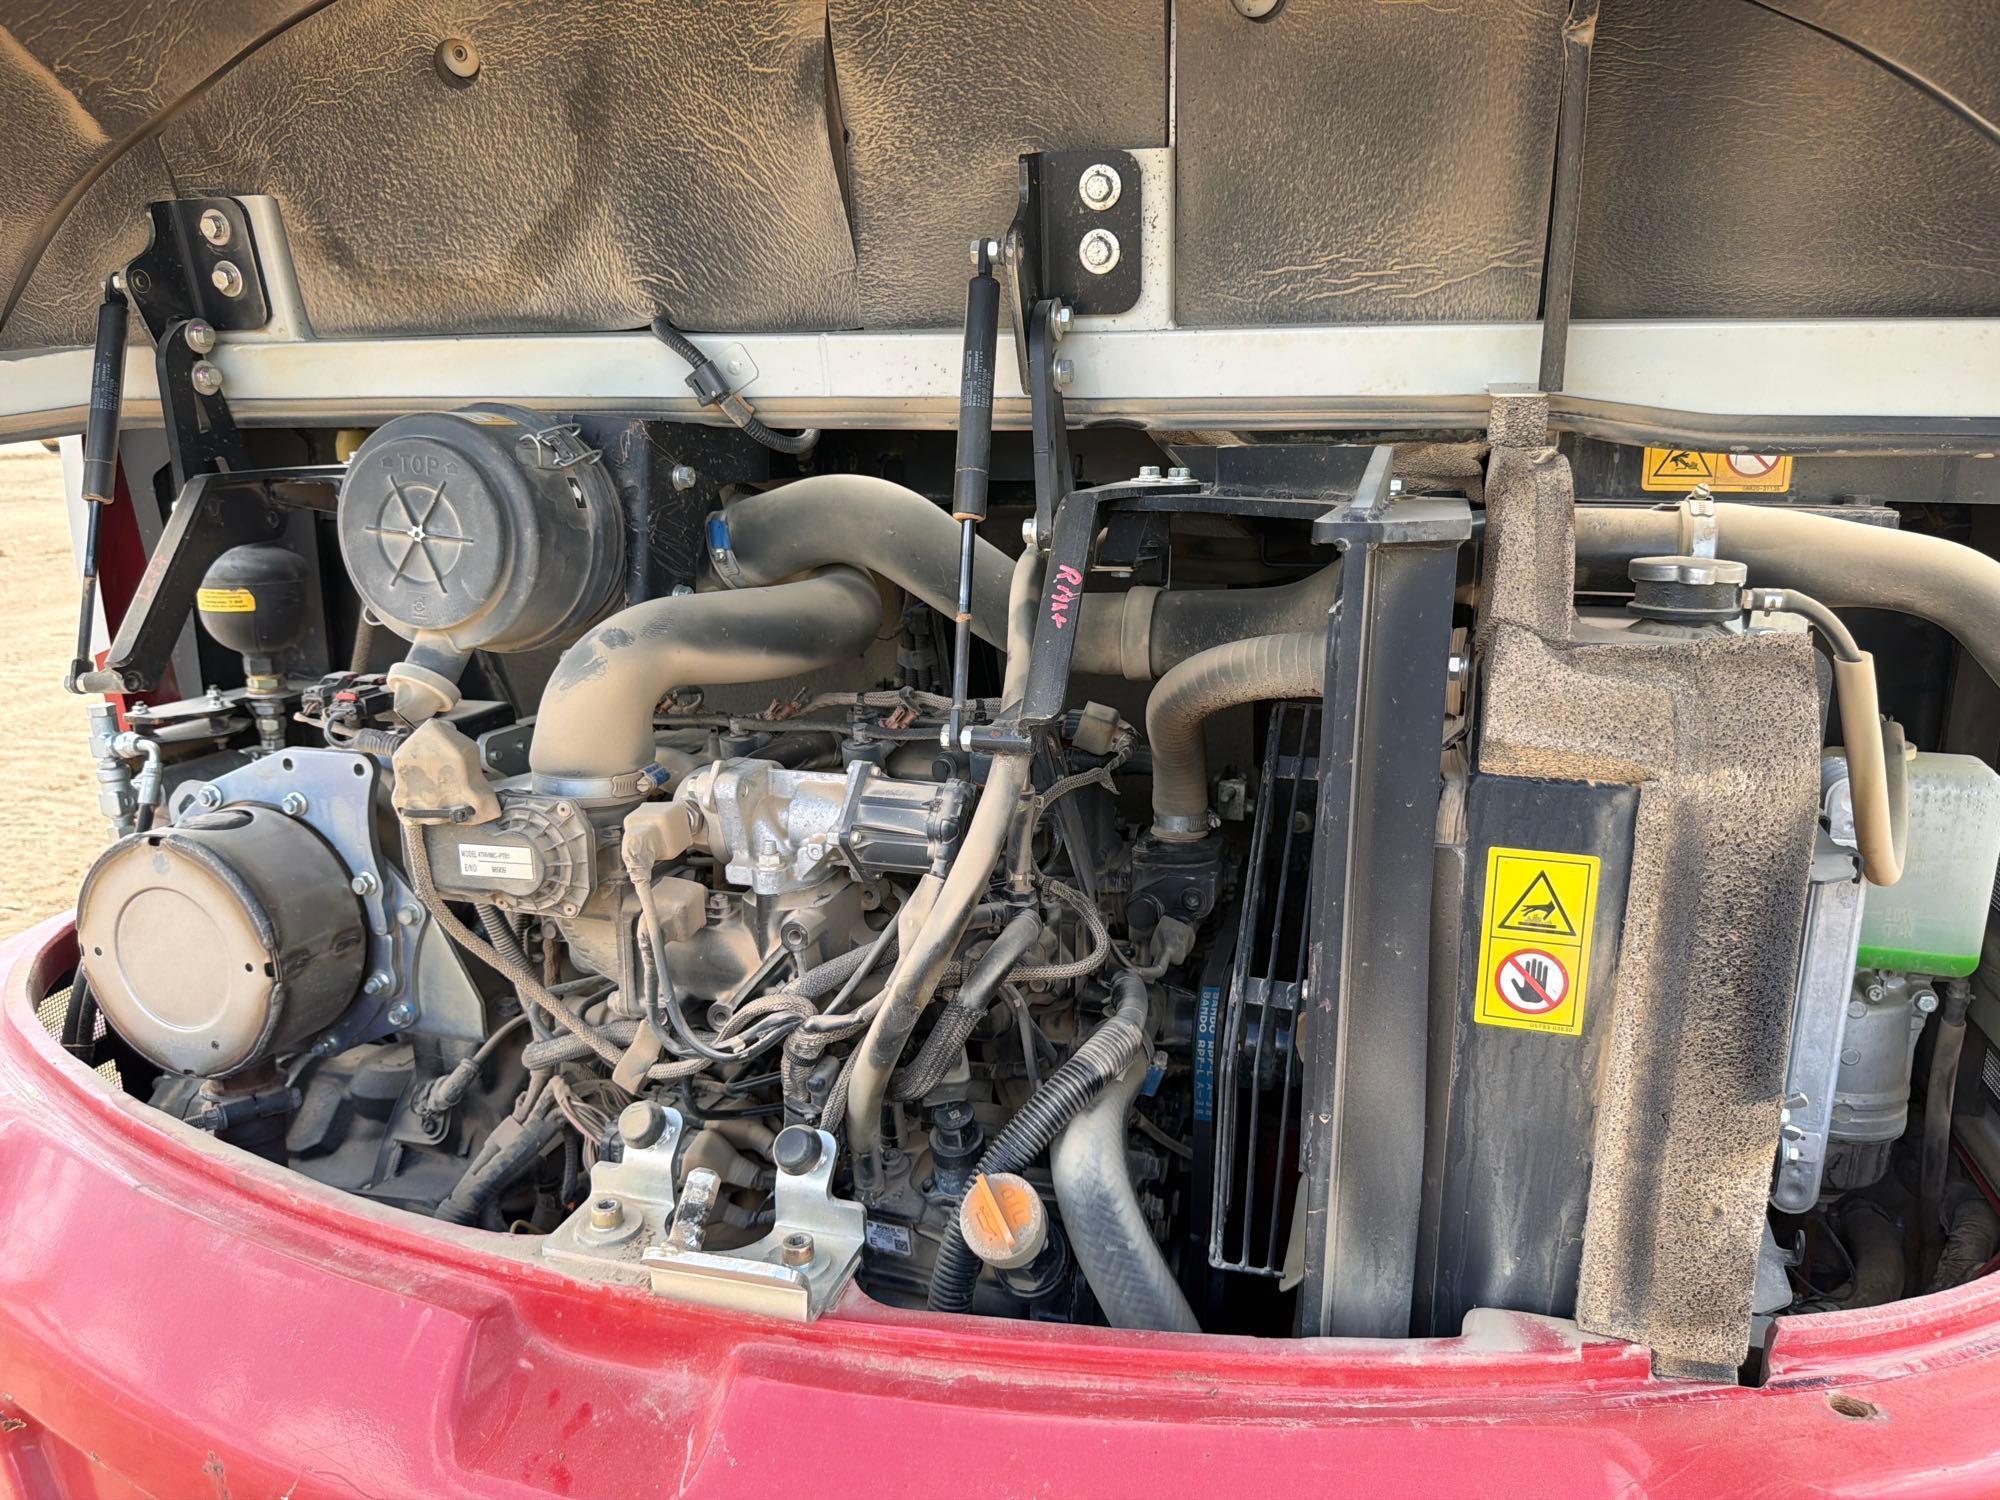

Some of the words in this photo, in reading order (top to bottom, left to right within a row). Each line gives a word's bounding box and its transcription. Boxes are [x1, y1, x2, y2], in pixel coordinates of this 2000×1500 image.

[396, 452, 440, 477] TOP
[1199, 991, 1212, 1033] BANDO
[1207, 991, 1220, 1034] BANDO
[1001, 1187, 1025, 1226] OIL
